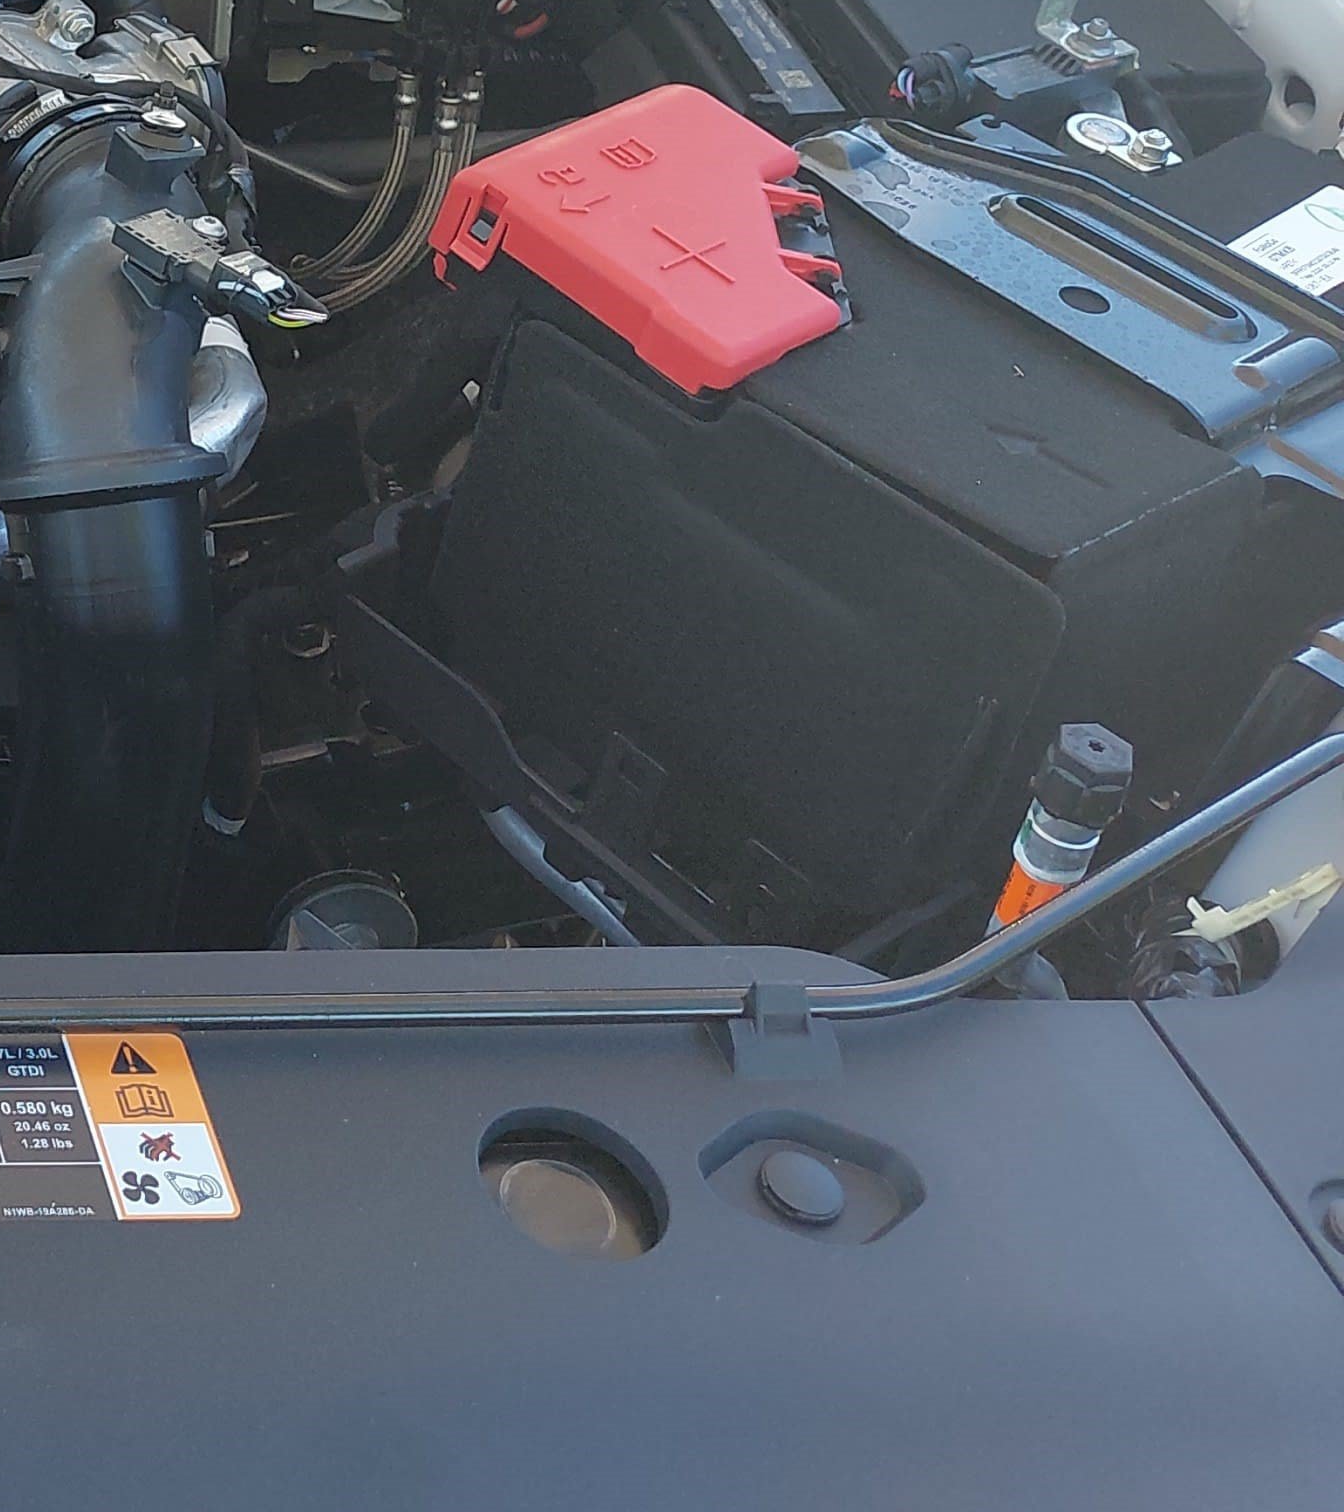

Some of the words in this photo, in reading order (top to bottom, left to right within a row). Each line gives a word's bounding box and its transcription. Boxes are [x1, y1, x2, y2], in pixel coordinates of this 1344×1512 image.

[25, 1048, 59, 1060] 3.0L
[7, 1065, 45, 1077] GTDI
[0, 1101, 47, 1116] 0.580
[50, 1101, 74, 1118] kg
[15, 1121, 53, 1133] 20.46
[55, 1123, 72, 1132] oz
[20, 1138, 48, 1149] 1.28
[51, 1138, 74, 1149] lbs
